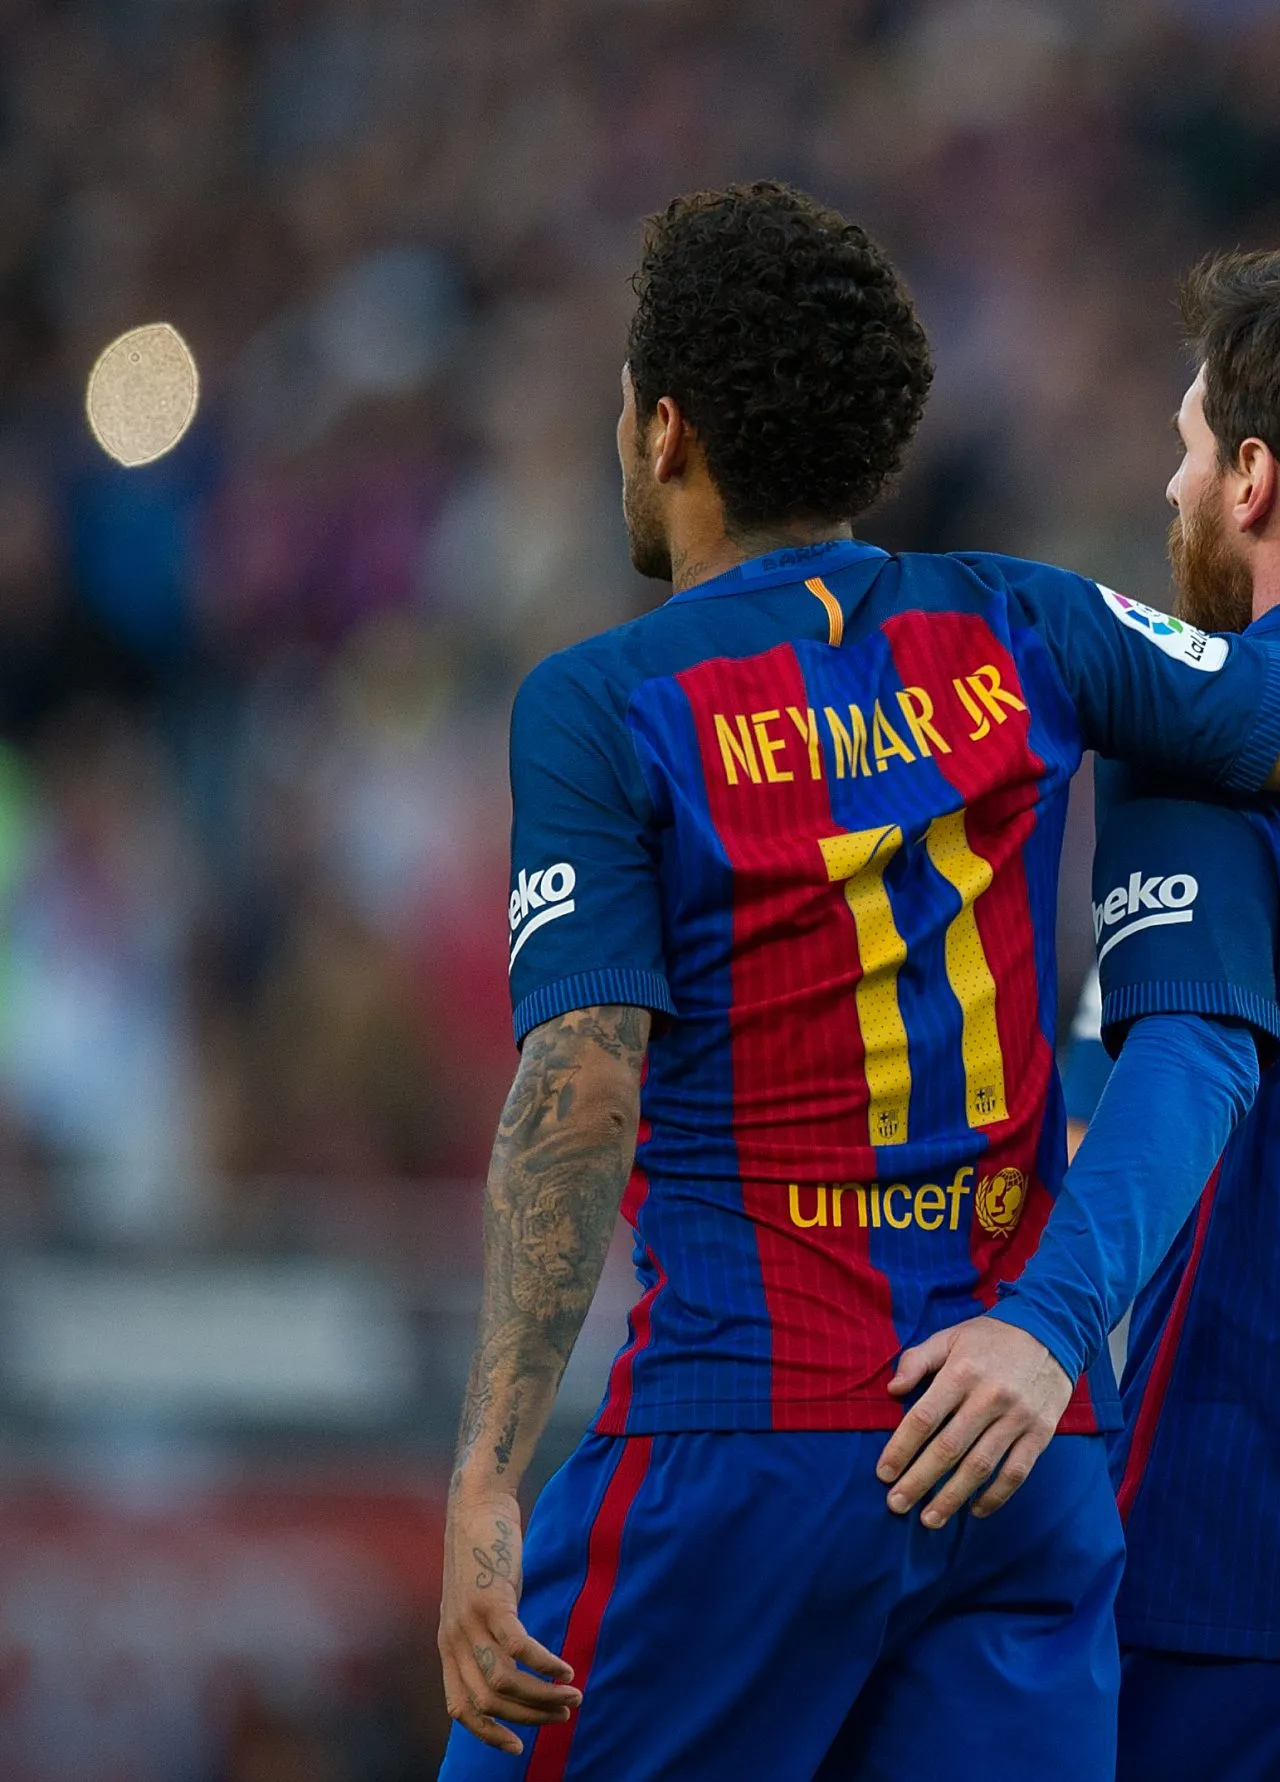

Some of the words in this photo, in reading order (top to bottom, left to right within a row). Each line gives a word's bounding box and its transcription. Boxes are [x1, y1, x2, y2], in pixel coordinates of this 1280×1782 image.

[713, 686, 952, 786] NEYMAR
[952, 664, 1027, 742] JR
[508, 862, 576, 931] eko
[817, 807, 1010, 1147] 11
[788, 1167, 974, 1231] unicef
